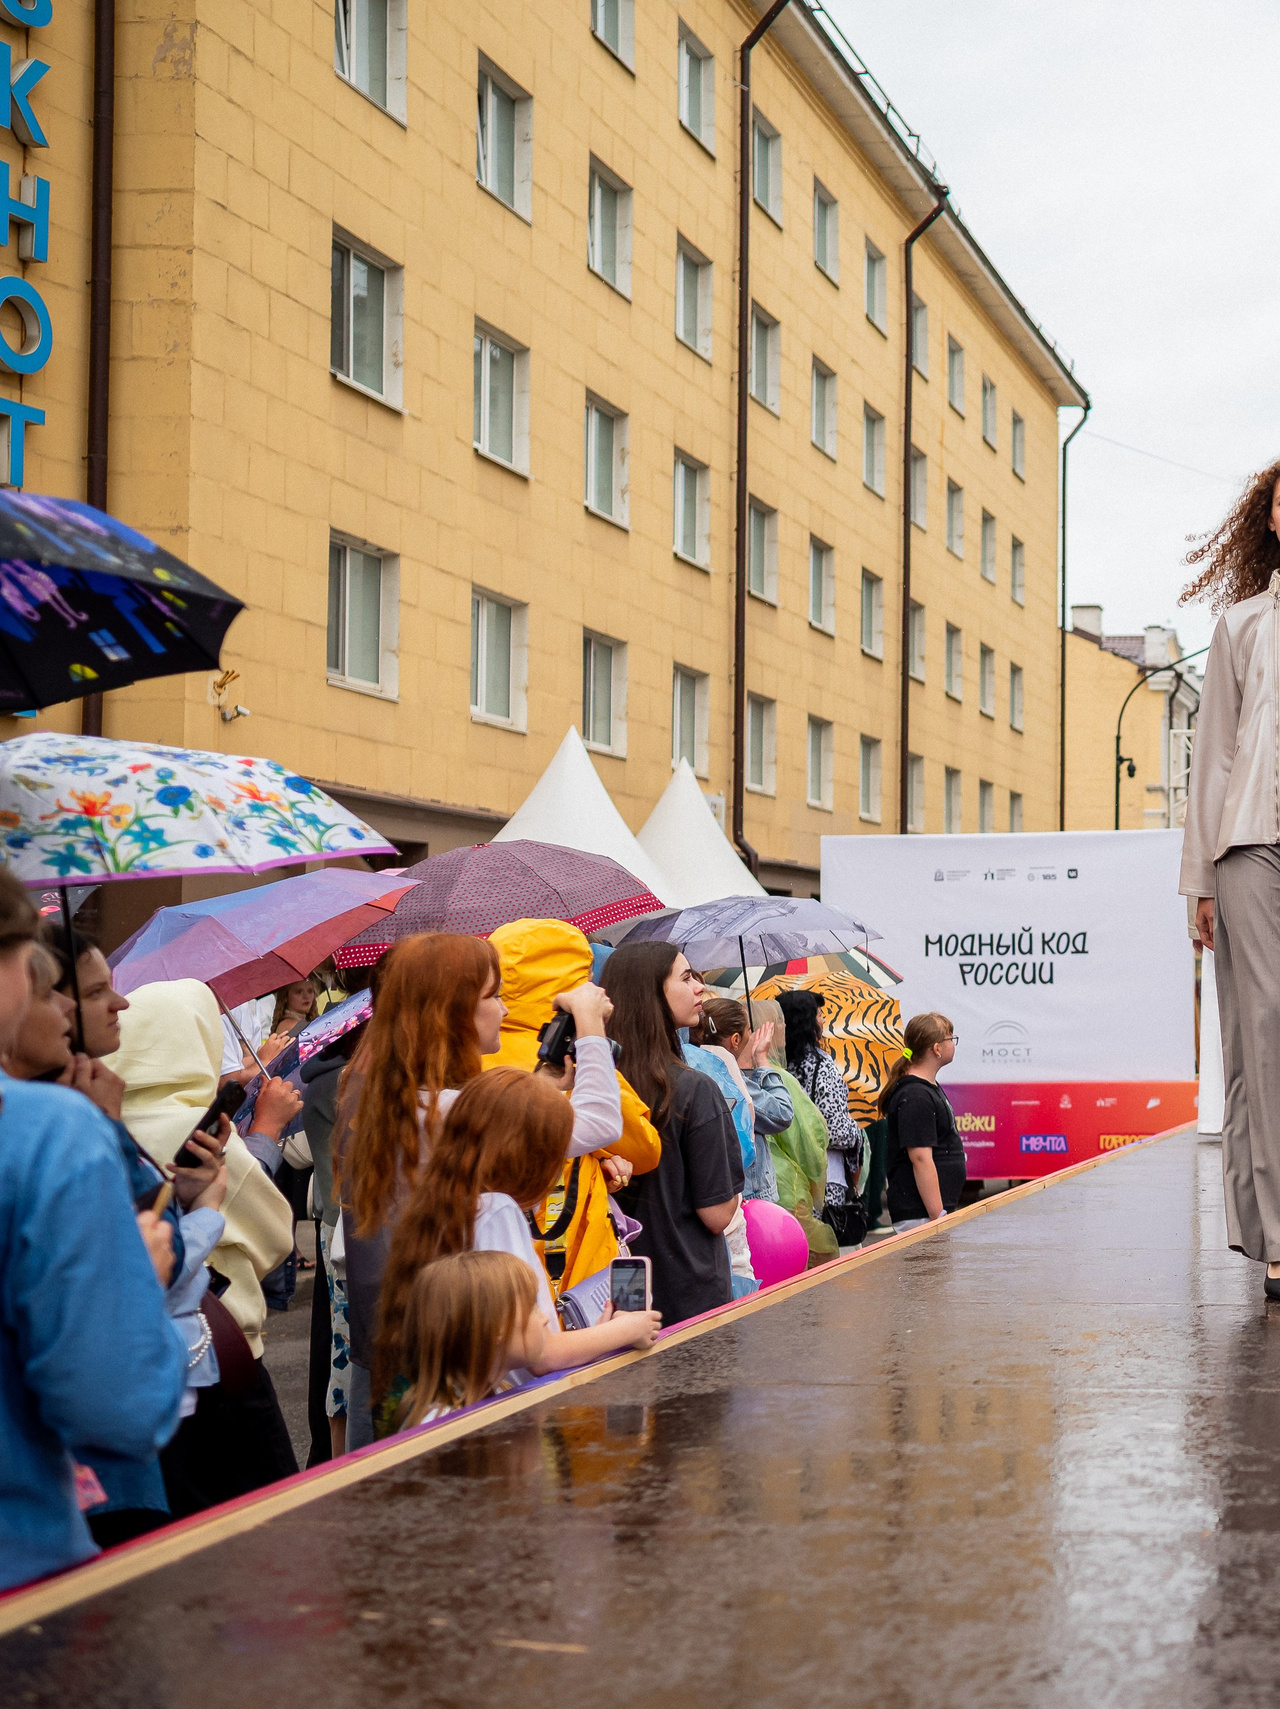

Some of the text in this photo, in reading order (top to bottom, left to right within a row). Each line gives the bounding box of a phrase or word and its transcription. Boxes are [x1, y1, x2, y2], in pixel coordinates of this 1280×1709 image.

[925, 926, 1089, 957] МОДНЫЙ КОД
[959, 961, 1054, 986] РОССИИ
[982, 1048, 1032, 1057] МОСТ
[1022, 1136, 1066, 1151] МЕЧТА
